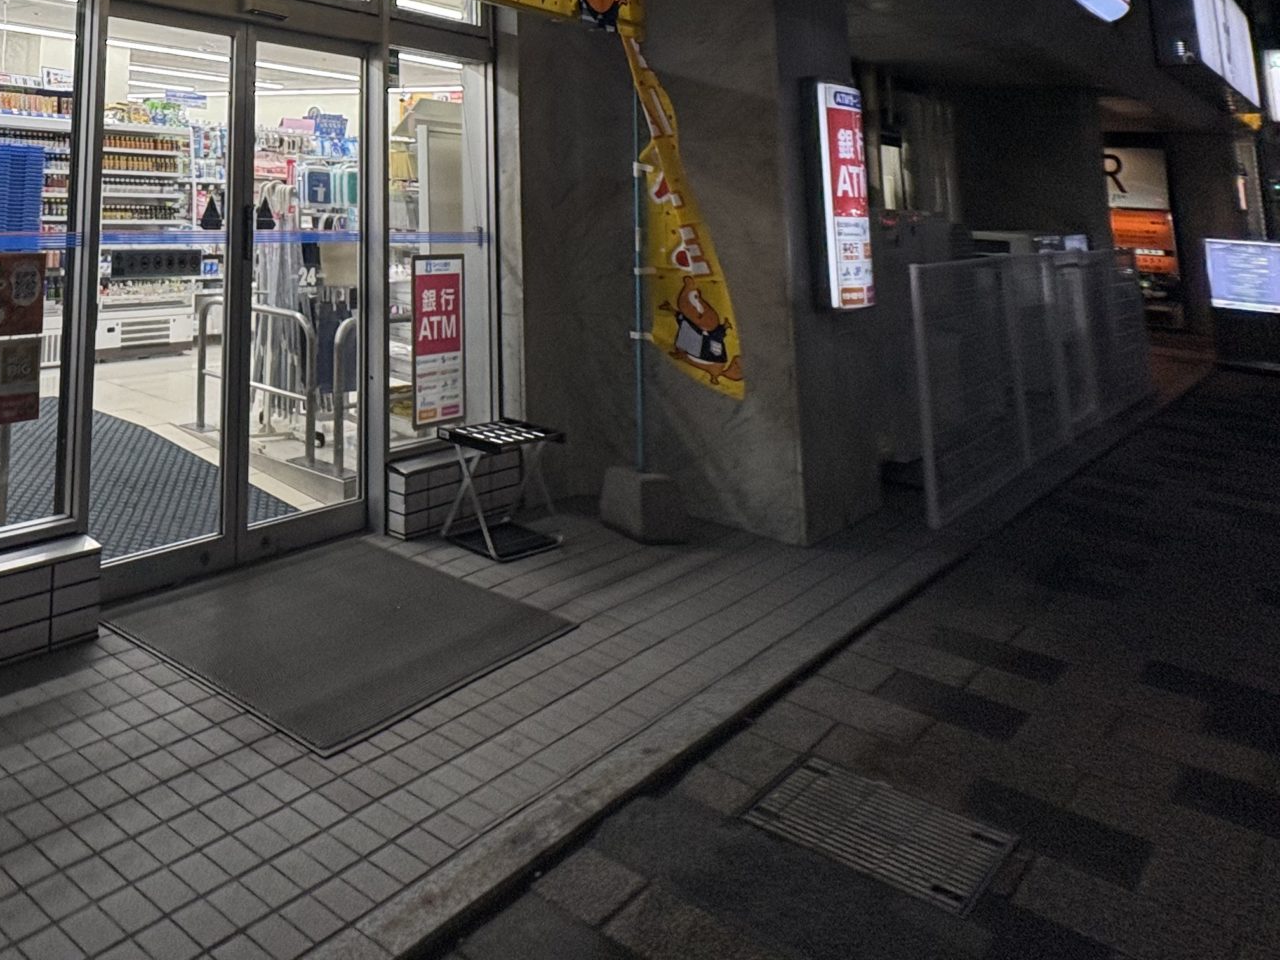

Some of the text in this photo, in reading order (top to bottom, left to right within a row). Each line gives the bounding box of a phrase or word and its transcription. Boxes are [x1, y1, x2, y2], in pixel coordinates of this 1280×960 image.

[298, 266, 317, 286] 24
[422, 289, 456, 313] 銀行
[419, 315, 457, 342] ATM
